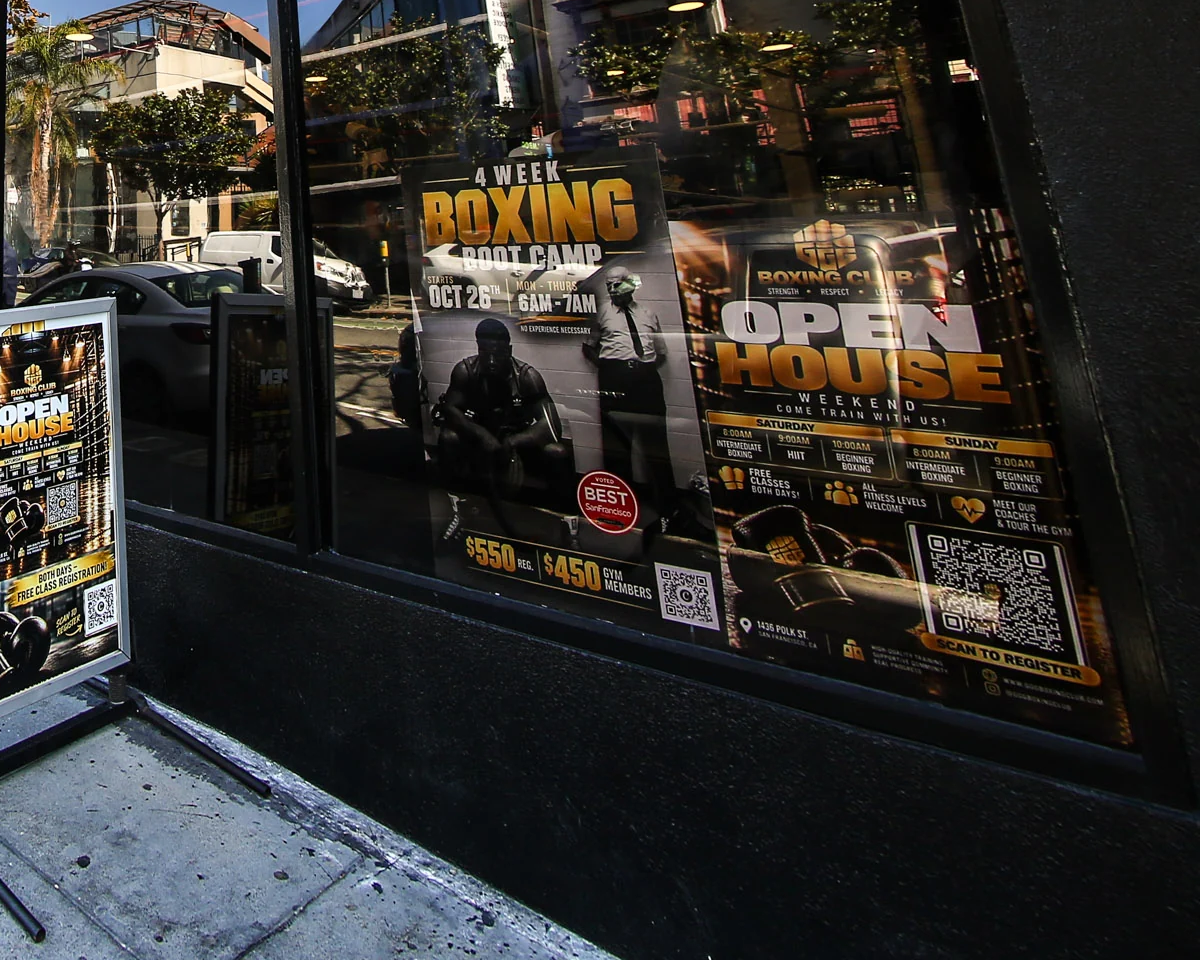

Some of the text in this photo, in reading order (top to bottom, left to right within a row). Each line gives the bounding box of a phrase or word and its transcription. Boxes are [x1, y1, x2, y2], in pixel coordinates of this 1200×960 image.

[475, 160, 561, 187] 4 WEEK
[422, 177, 638, 246] BOXING
[461, 243, 602, 271] BOOT CAMP
[427, 275, 454, 285] STARTS
[757, 268, 916, 286] BOXING CLUB
[516, 281, 536, 291] MON
[547, 280, 578, 291] THURS
[767, 287, 904, 297] STRENGTH RESPECT LEGACY
[428, 284, 462, 309] OCT
[517, 293, 552, 313] 6AM
[562, 293, 597, 314] 7AM
[520, 325, 591, 335] NO EXPERIENCE NECESSARY
[720, 300, 983, 353] OPEN
[714, 341, 1012, 405] HOUSE
[11, 386, 37, 397] BOXING
[38, 382, 56, 392] CLUB
[798, 392, 916, 412] WEEKEND
[776, 404, 947, 427] COME TRAIN WITH US!
[19, 436, 53, 448] WEEKEND
[756, 418, 999, 450] SATURDAY SUNDAY
[716, 439, 763, 452] INTERMEDIATE
[777, 434, 811, 445] 9:00AM
[832, 440, 871, 452] 10:00AM
[727, 449, 753, 459] BOXING
[787, 450, 806, 461] HIIT
[836, 452, 875, 465] BEGINNER
[912, 448, 1035, 469] 8:00AM 9:00AM
[749, 467, 772, 479] FREE
[842, 462, 872, 474] BOXING
[905, 460, 966, 476] INTERMEDIATE
[750, 477, 791, 489] CLASSES
[921, 471, 954, 483] BOXING
[996, 470, 1043, 484] BEGINNER
[751, 485, 800, 499] BOTH DAYS!
[862, 482, 877, 492] ALL
[1003, 481, 1039, 494] BOXING
[584, 486, 628, 506] BEST
[863, 491, 927, 508] FITNESS LEVELS
[865, 500, 904, 514] WELCOME
[992, 499, 1036, 513] MEET OUR
[995, 509, 1037, 523] COACHES
[997, 519, 1073, 537] & TOUR THE GYM
[466, 535, 602, 592] $550 REG. $450
[17, 561, 107, 602] FREE CLASS REGISTRATION!
[38, 569, 55, 583] BOTH
[56, 564, 72, 579] DAYS
[603, 567, 623, 581] GYM
[605, 579, 652, 600] MEMBERS
[55, 607, 78, 628] SCAN TO
[56, 613, 81, 637] REGISTER
[776, 624, 797, 637] POLK
[797, 628, 809, 640] ST.
[936, 638, 1083, 680] SCAN TO REGISTER
